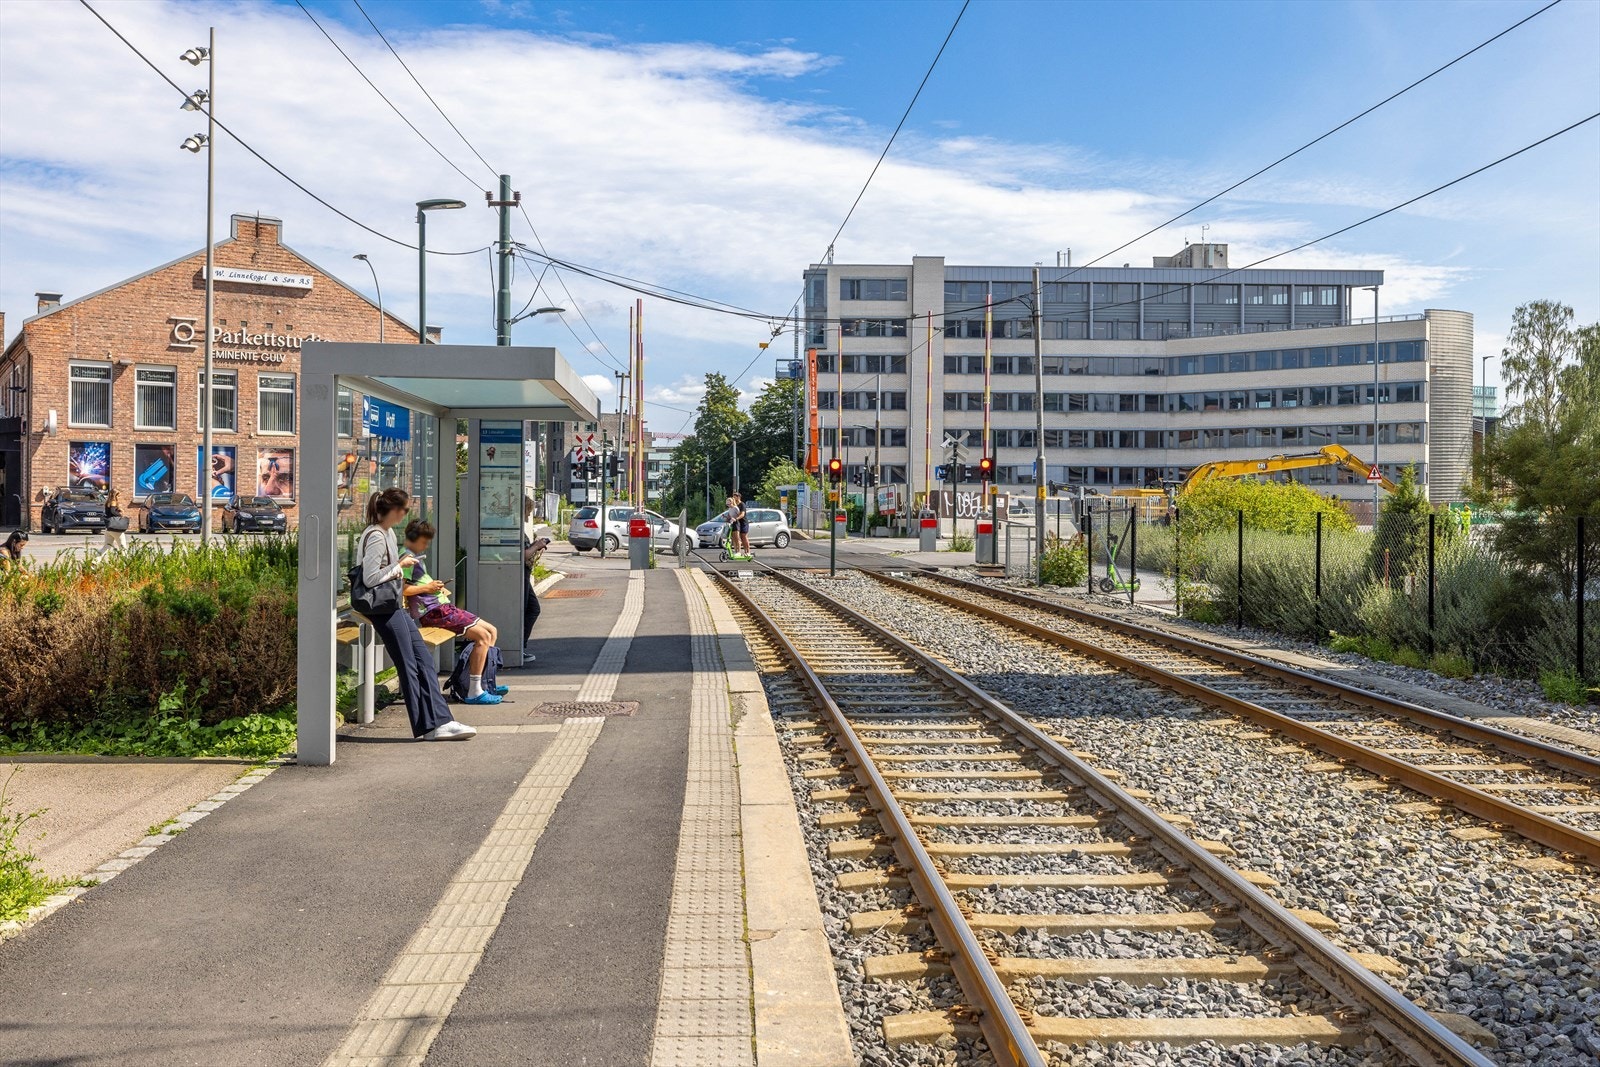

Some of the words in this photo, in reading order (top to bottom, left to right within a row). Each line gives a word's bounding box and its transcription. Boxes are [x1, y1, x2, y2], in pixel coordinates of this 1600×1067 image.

[228, 271, 268, 282] Linnekogel
[211, 327, 332, 348] Parkettstudi
[211, 350, 259, 361] EMINENTE
[261, 353, 287, 362] GULV
[385, 411, 396, 428] Hoff
